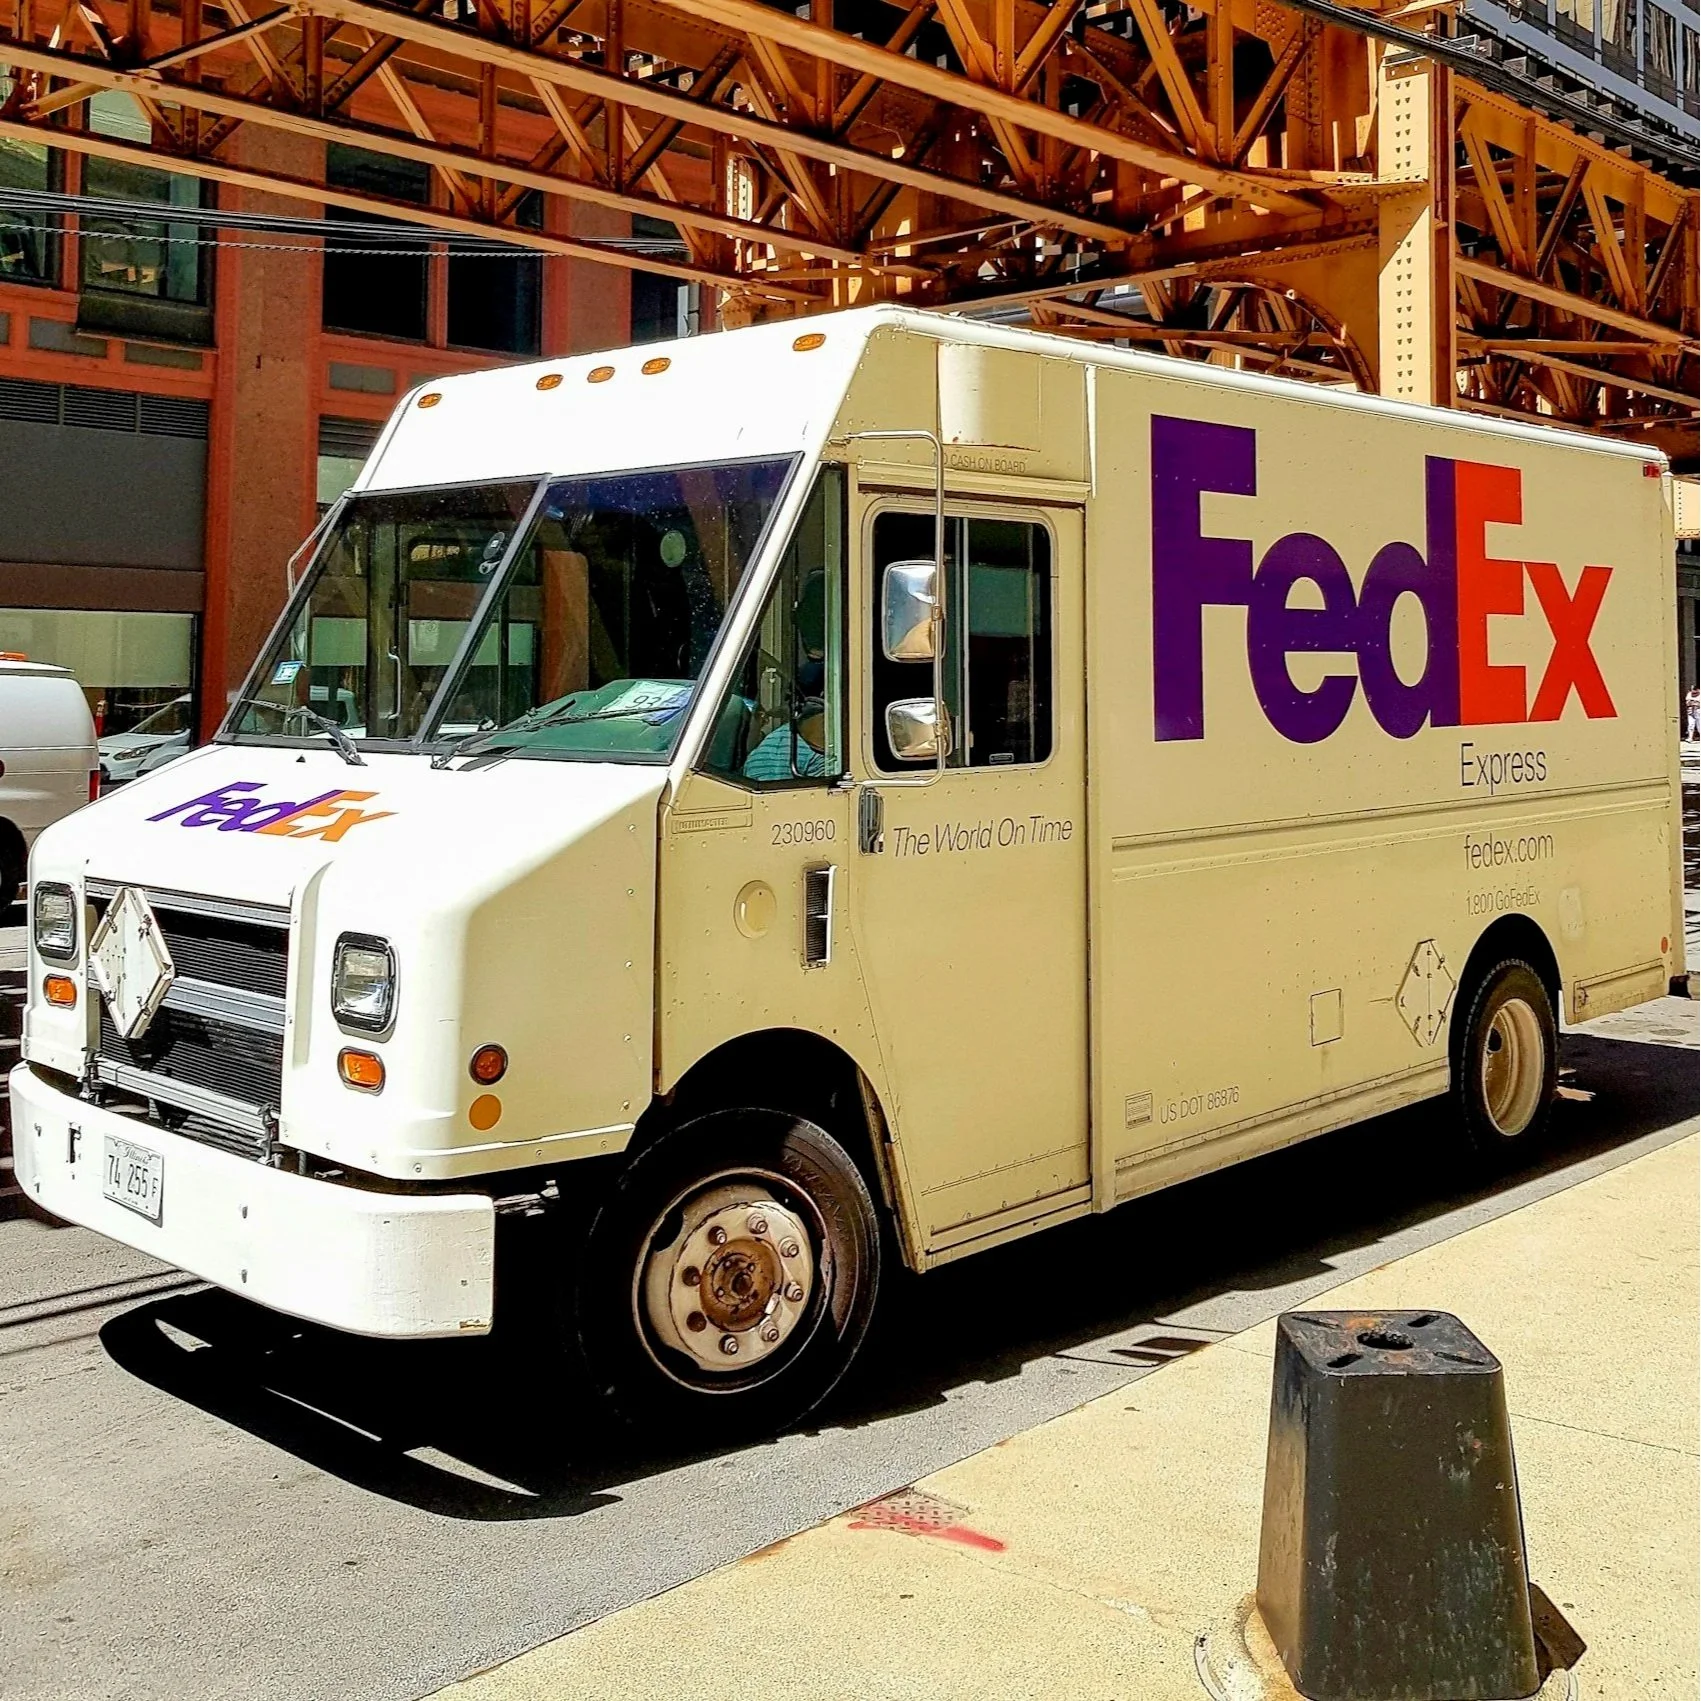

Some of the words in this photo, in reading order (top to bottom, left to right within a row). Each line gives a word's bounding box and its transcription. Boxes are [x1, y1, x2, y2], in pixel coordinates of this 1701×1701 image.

[950, 453, 976, 469] CASH
[977, 457, 993, 470] ON
[994, 458, 1026, 474] BOARD
[1151, 413, 1619, 744] FedEx
[1460, 742, 1548, 796] Express
[144, 781, 400, 843] FedEx
[770, 818, 837, 846] 230960
[893, 826, 930, 858] The
[934, 819, 994, 854] World
[997, 817, 1026, 847] On
[1029, 814, 1074, 844] Time
[1463, 832, 1554, 871] fedex.com
[1160, 1101, 1178, 1125] US
[1180, 1094, 1205, 1119] DOT
[1207, 1085, 1240, 1111] 86876
[108, 1154, 121, 1189] 74
[127, 1163, 149, 1199] 255
